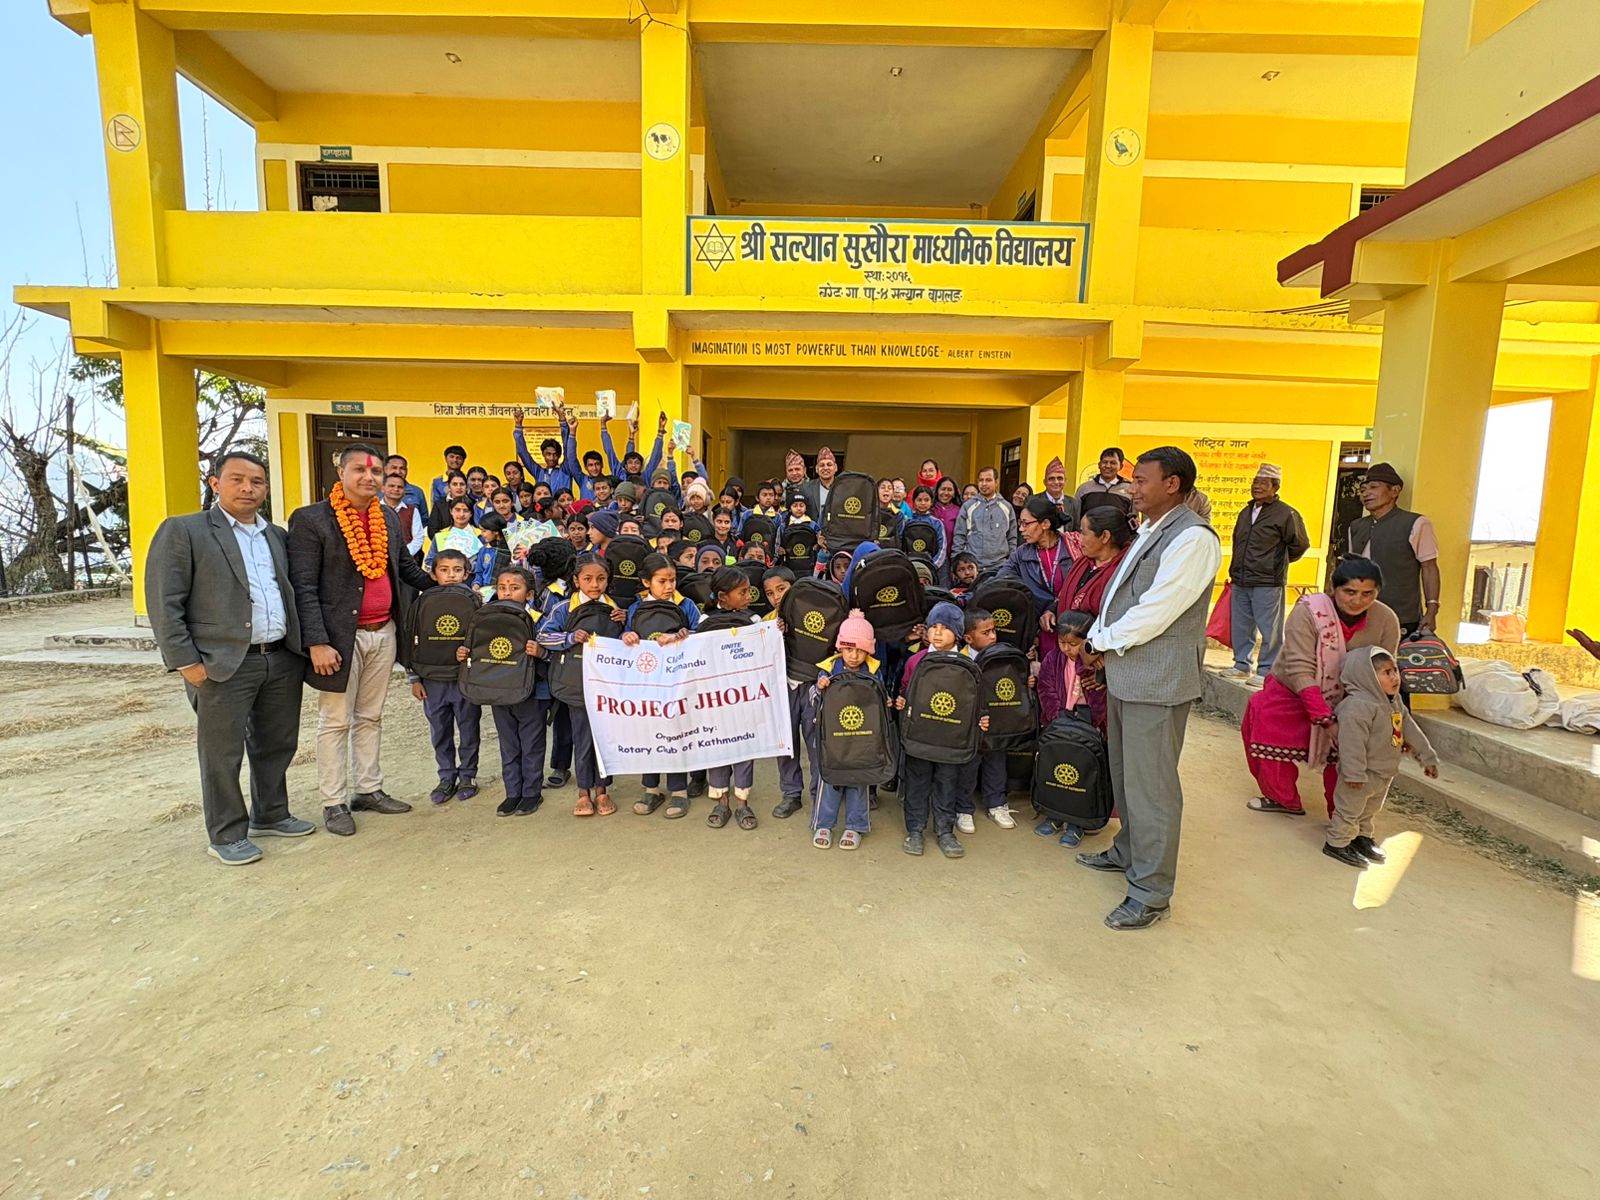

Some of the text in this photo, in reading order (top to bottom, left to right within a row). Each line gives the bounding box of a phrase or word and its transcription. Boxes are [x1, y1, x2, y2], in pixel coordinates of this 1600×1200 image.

[741, 222, 1076, 269] श्री सल्यान सुखौरा माध्यमिक विद्यालय
[691, 342, 748, 355] IMAGINATION
[752, 343, 761, 355] IS
[765, 343, 791, 356] MOST
[796, 343, 847, 356] POWERFUL
[850, 344, 876, 357] THAN
[948, 349, 974, 359] ALBERT
[978, 349, 1012, 360] EINSTEIN
[1229, 440, 1250, 449] गान
[721, 642, 742, 651] UNITE
[730, 647, 744, 655] FOR
[596, 653, 634, 669] Rotary
[733, 651, 754, 660] GOOD
[596, 682, 770, 720] PROJECT JHOLA
[655, 727, 700, 743] Organized
[618, 732, 755, 755] Rotary Club of Kathmandu
